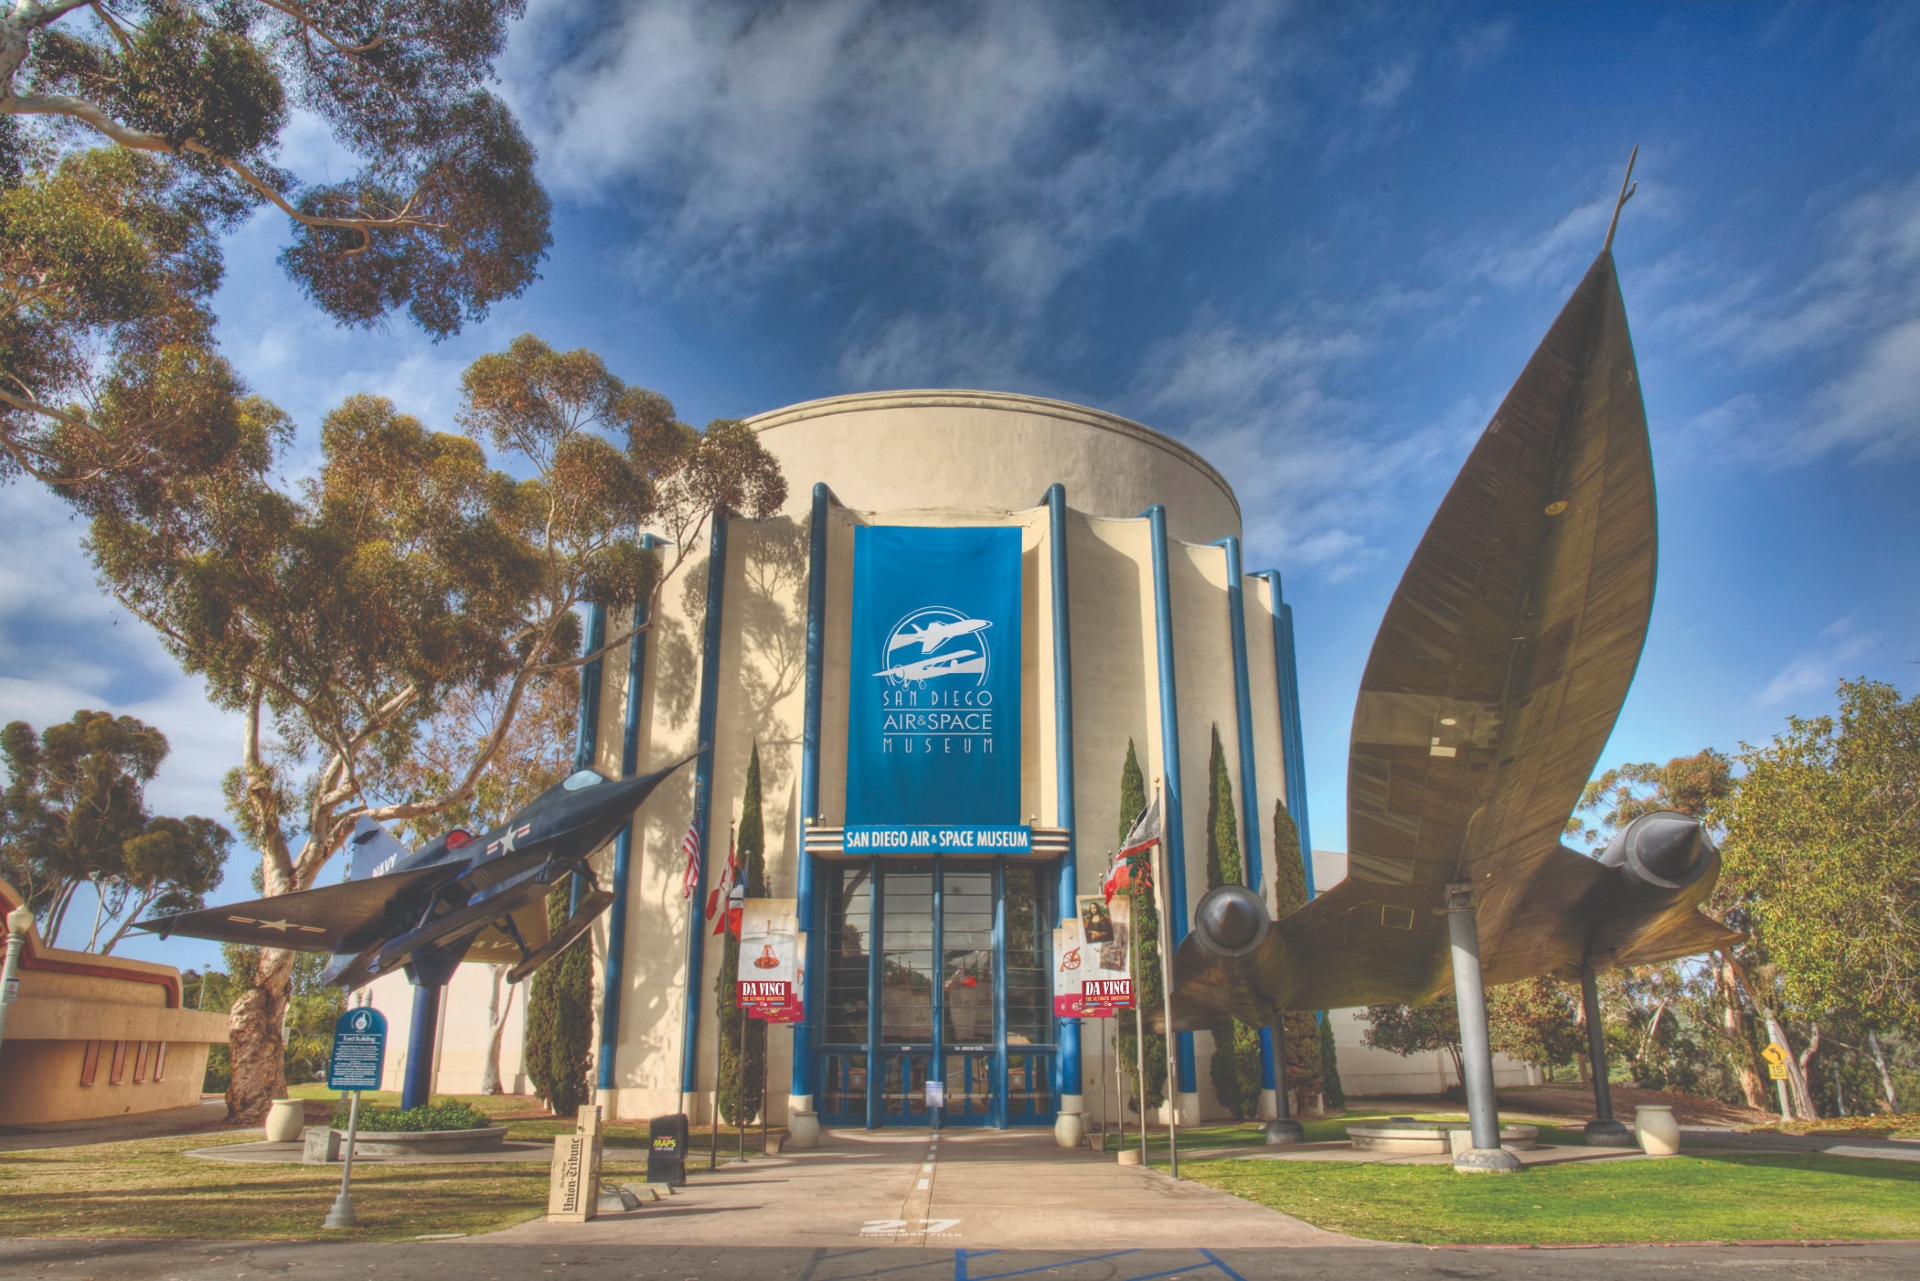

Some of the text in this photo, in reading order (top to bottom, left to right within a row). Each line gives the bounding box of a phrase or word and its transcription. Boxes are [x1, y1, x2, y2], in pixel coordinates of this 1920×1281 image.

[883, 690, 993, 707] SAN DIEGO
[883, 738, 993, 754] MUSEUM
[846, 831, 1028, 848] SAN DIEGO AIR & SPACE MUSEUM
[372, 853, 398, 877] NAVY
[742, 982, 785, 996] DA VINCI
[1085, 980, 1130, 996] DA VINCI
[653, 1139, 676, 1147] MAPS
[563, 1138, 580, 1212] Union-Tribune
[860, 1218, 961, 1233] 27
